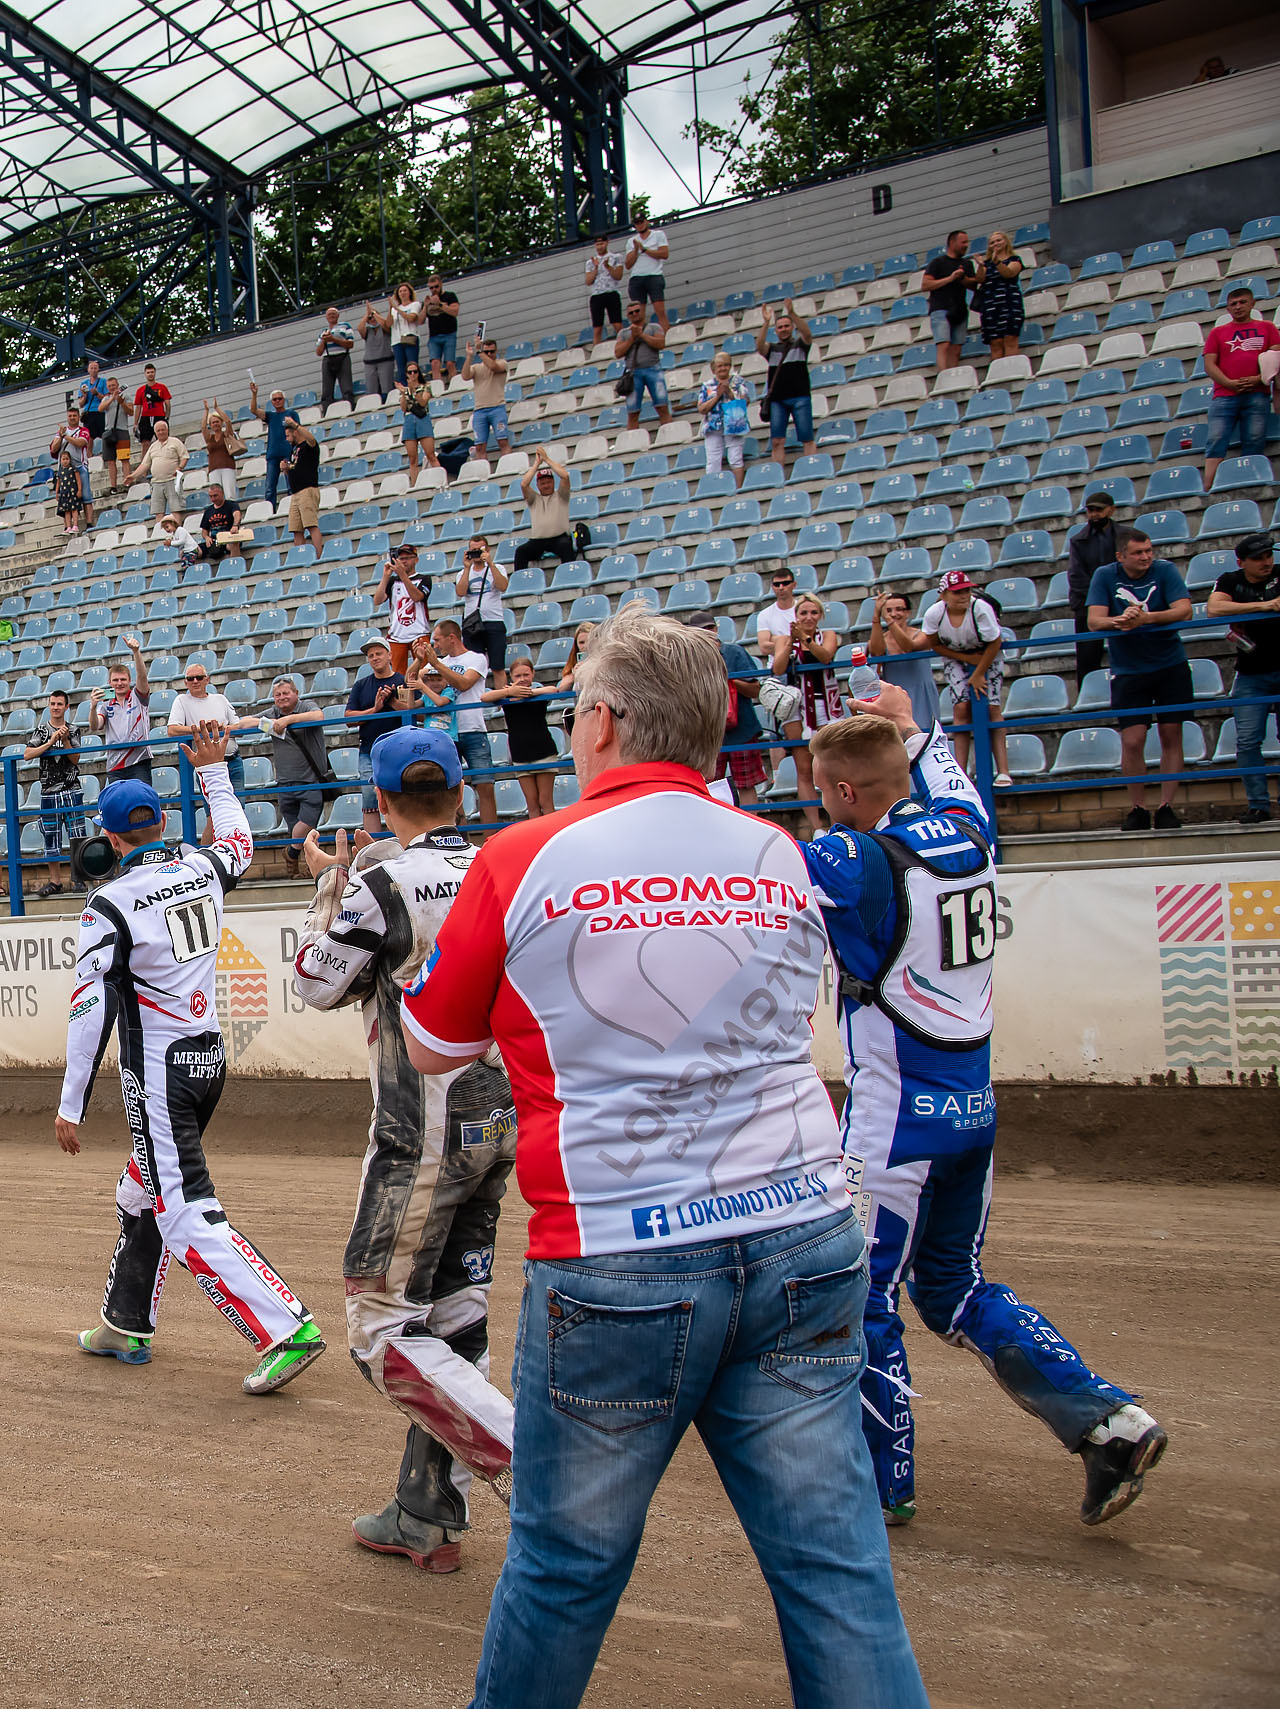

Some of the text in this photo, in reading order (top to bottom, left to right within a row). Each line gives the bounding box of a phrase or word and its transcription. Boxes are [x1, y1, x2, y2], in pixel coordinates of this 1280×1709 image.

[872, 184, 893, 216] D
[543, 874, 809, 921] LOKOMOTIV
[174, 902, 210, 954] 11
[589, 907, 791, 935] DAUGAVPILS
[942, 887, 995, 968] 13
[173, 1047, 224, 1066] MERIDIAN
[189, 1065, 216, 1078] LIFTS
[482, 1117, 515, 1144] REALL
[954, 1112, 994, 1128] SPORTS
[204, 1278, 261, 1346] MERIDIAN LIFTS
